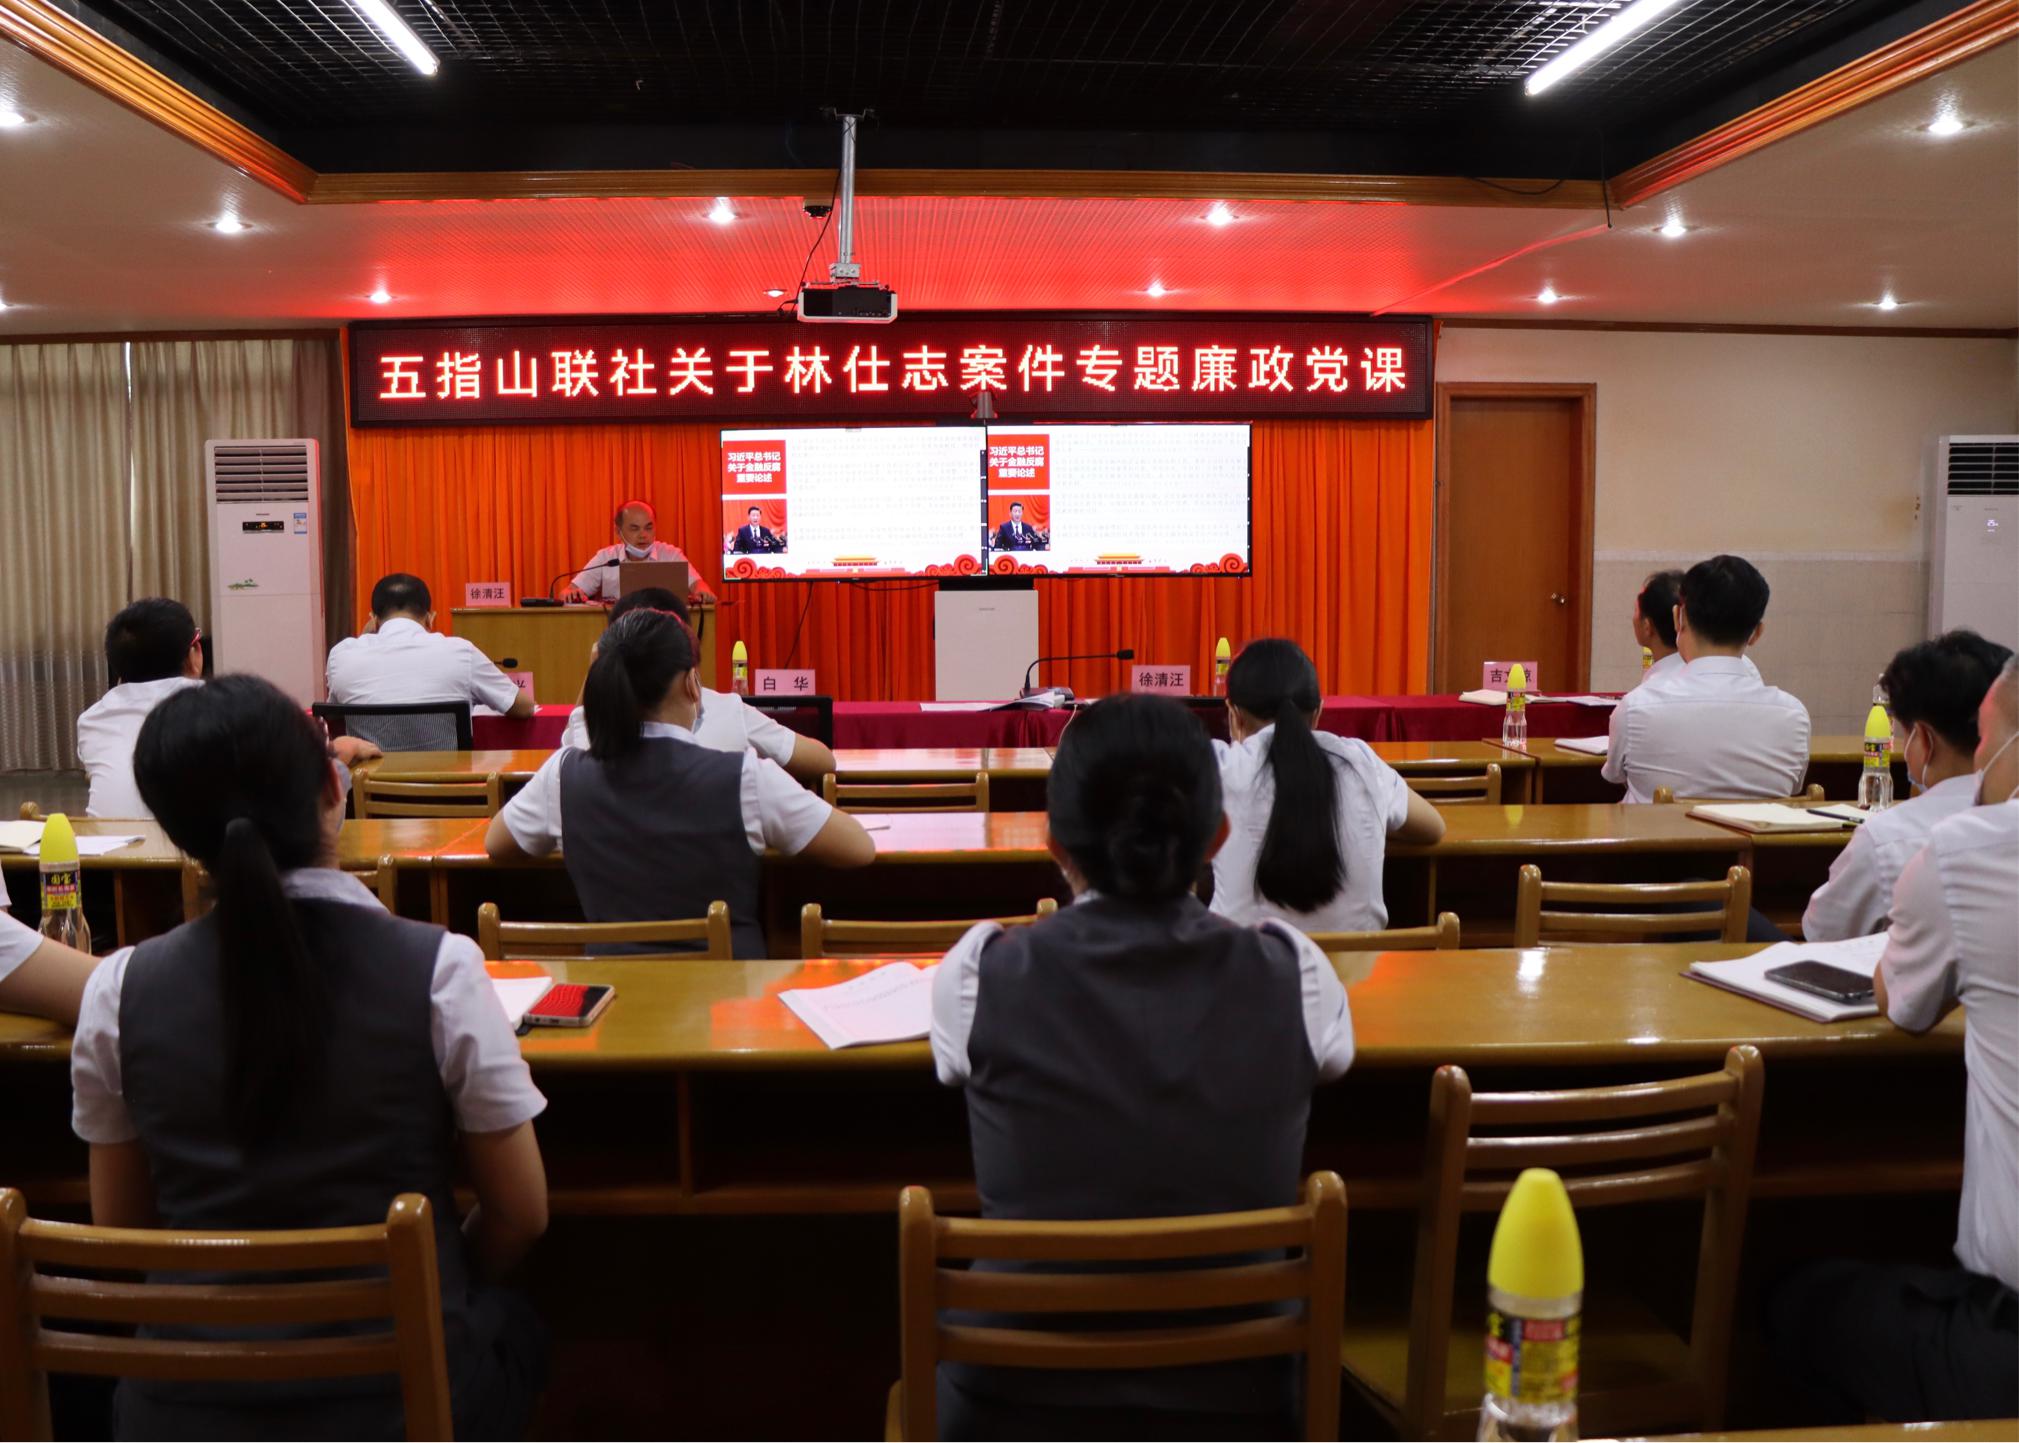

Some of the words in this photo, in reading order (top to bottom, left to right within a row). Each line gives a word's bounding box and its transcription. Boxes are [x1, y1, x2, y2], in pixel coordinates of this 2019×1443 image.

[379, 344, 1406, 400] 五指山联社关于林仕志案件专题廉政党课
[1139, 671, 1184, 687] 徐清汪
